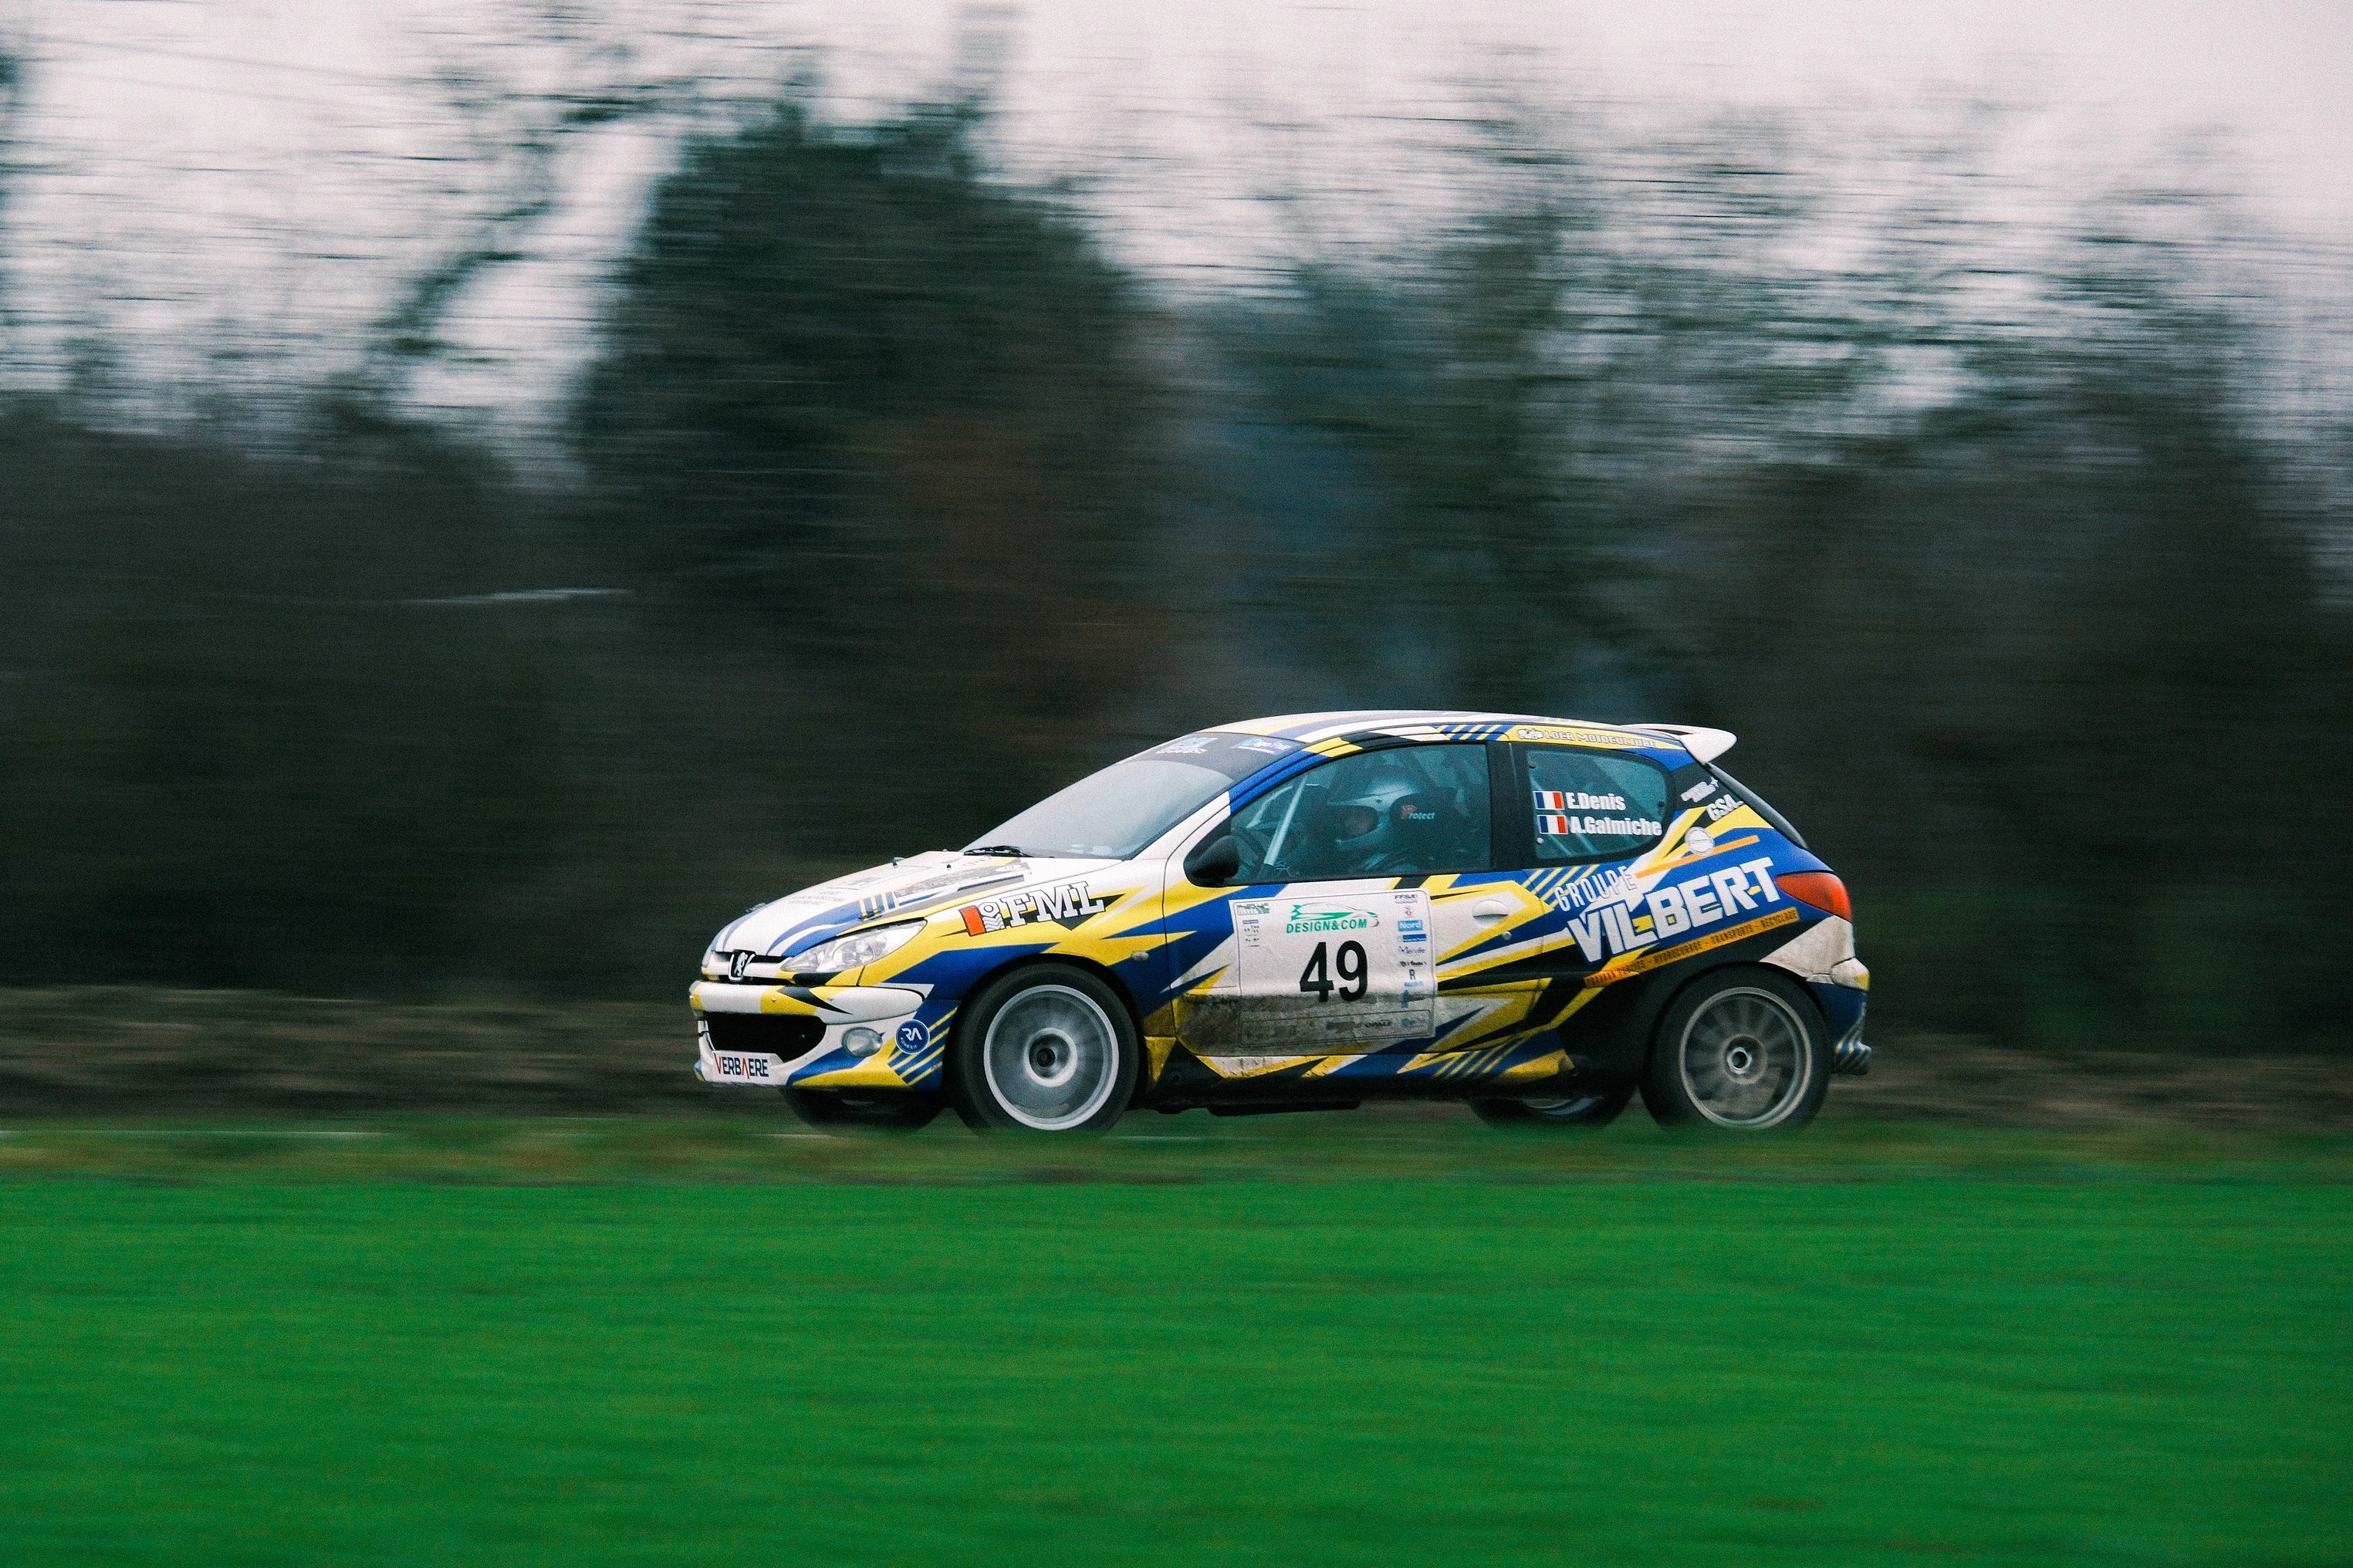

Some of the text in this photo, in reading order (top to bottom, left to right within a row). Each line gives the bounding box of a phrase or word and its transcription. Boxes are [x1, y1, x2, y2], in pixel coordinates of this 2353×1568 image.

[1565, 792, 1627, 811] E.Denis
[1570, 816, 1663, 836] A.Galmiche
[1554, 865, 1638, 912] GROUPE
[999, 880, 1106, 928] FML
[1286, 918, 1368, 934] DESIGN&COM
[1299, 940, 1368, 1002] 49
[713, 1053, 769, 1080] VERBAERE
